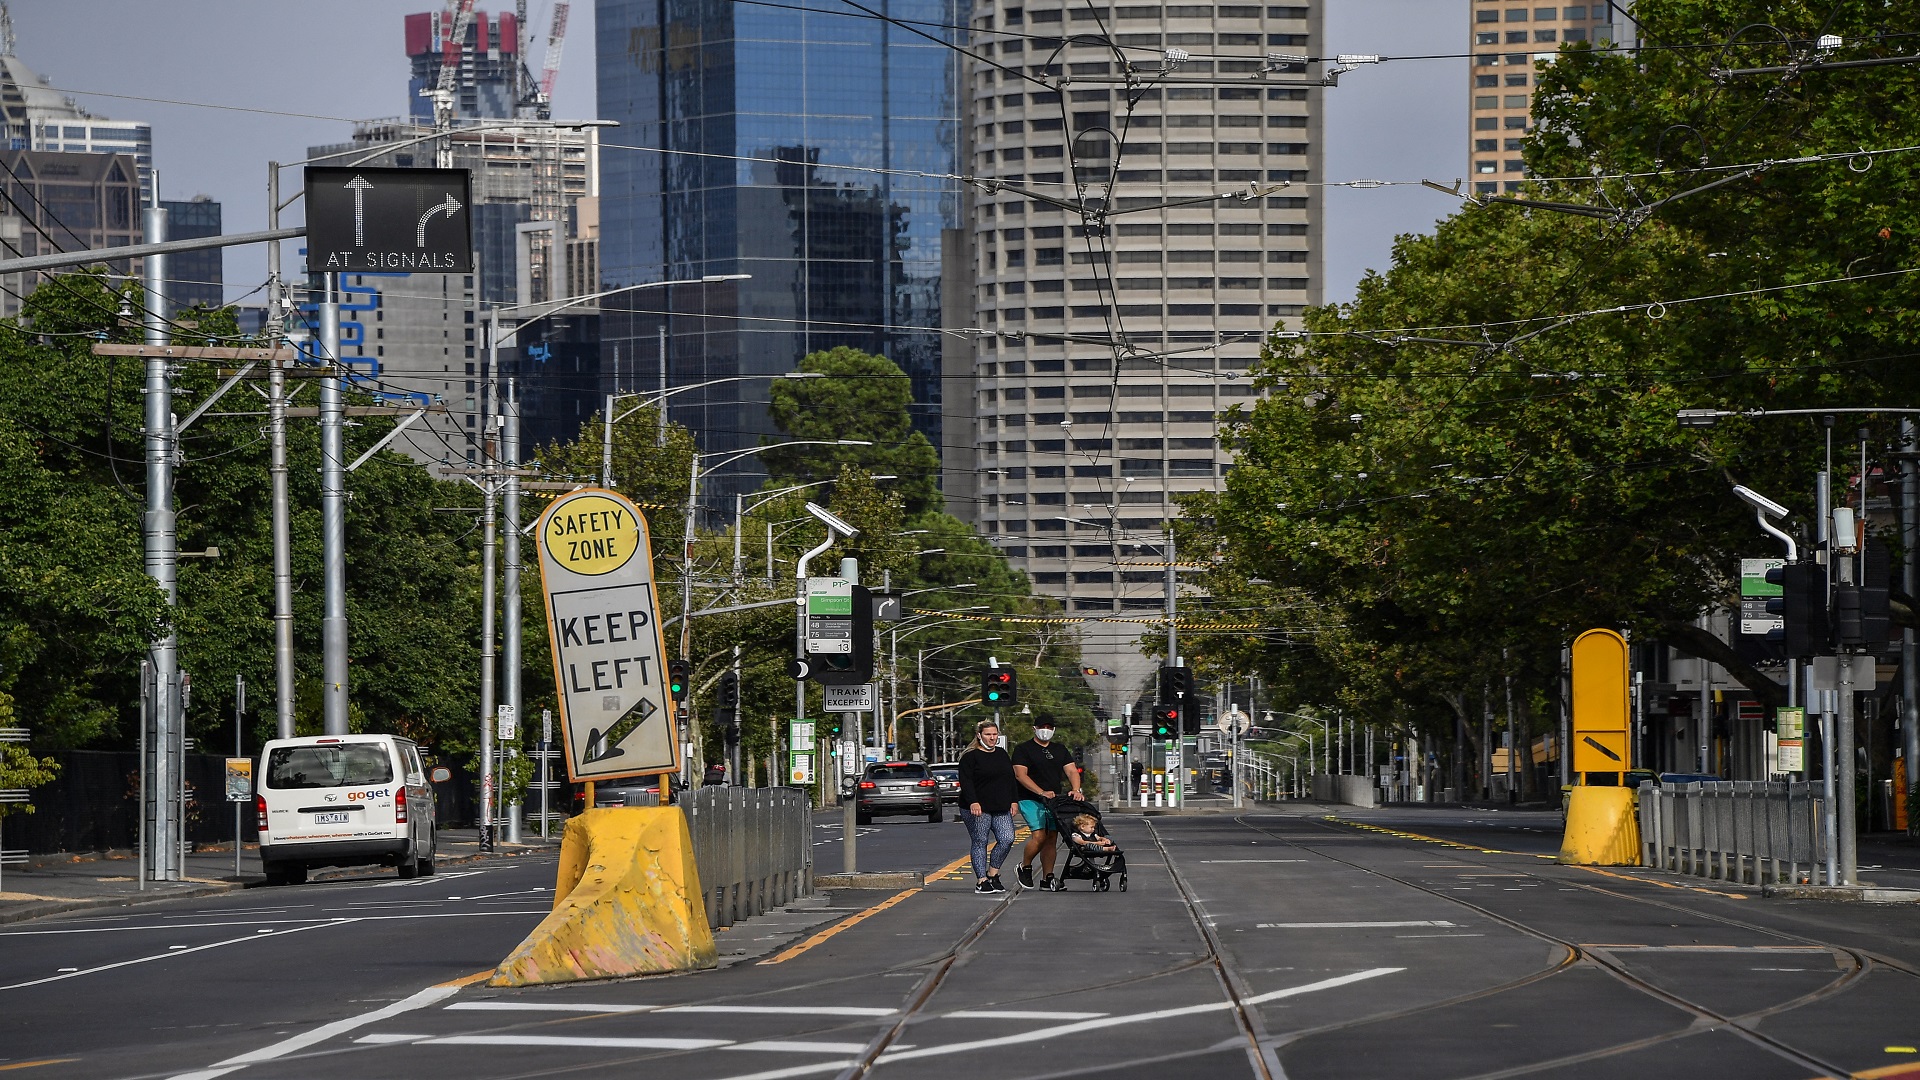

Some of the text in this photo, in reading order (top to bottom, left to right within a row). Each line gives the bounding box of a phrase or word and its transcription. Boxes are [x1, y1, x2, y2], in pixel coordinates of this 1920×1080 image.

[327, 251, 455, 268] AT SIGNALS
[553, 509, 622, 536] SAFETY
[568, 537, 617, 562] ZONE
[560, 610, 648, 648] KEEP
[838, 643, 849, 652] 13
[570, 655, 651, 693] LEFT
[831, 688, 867, 696] TRAMS
[347, 788, 390, 801] goget
